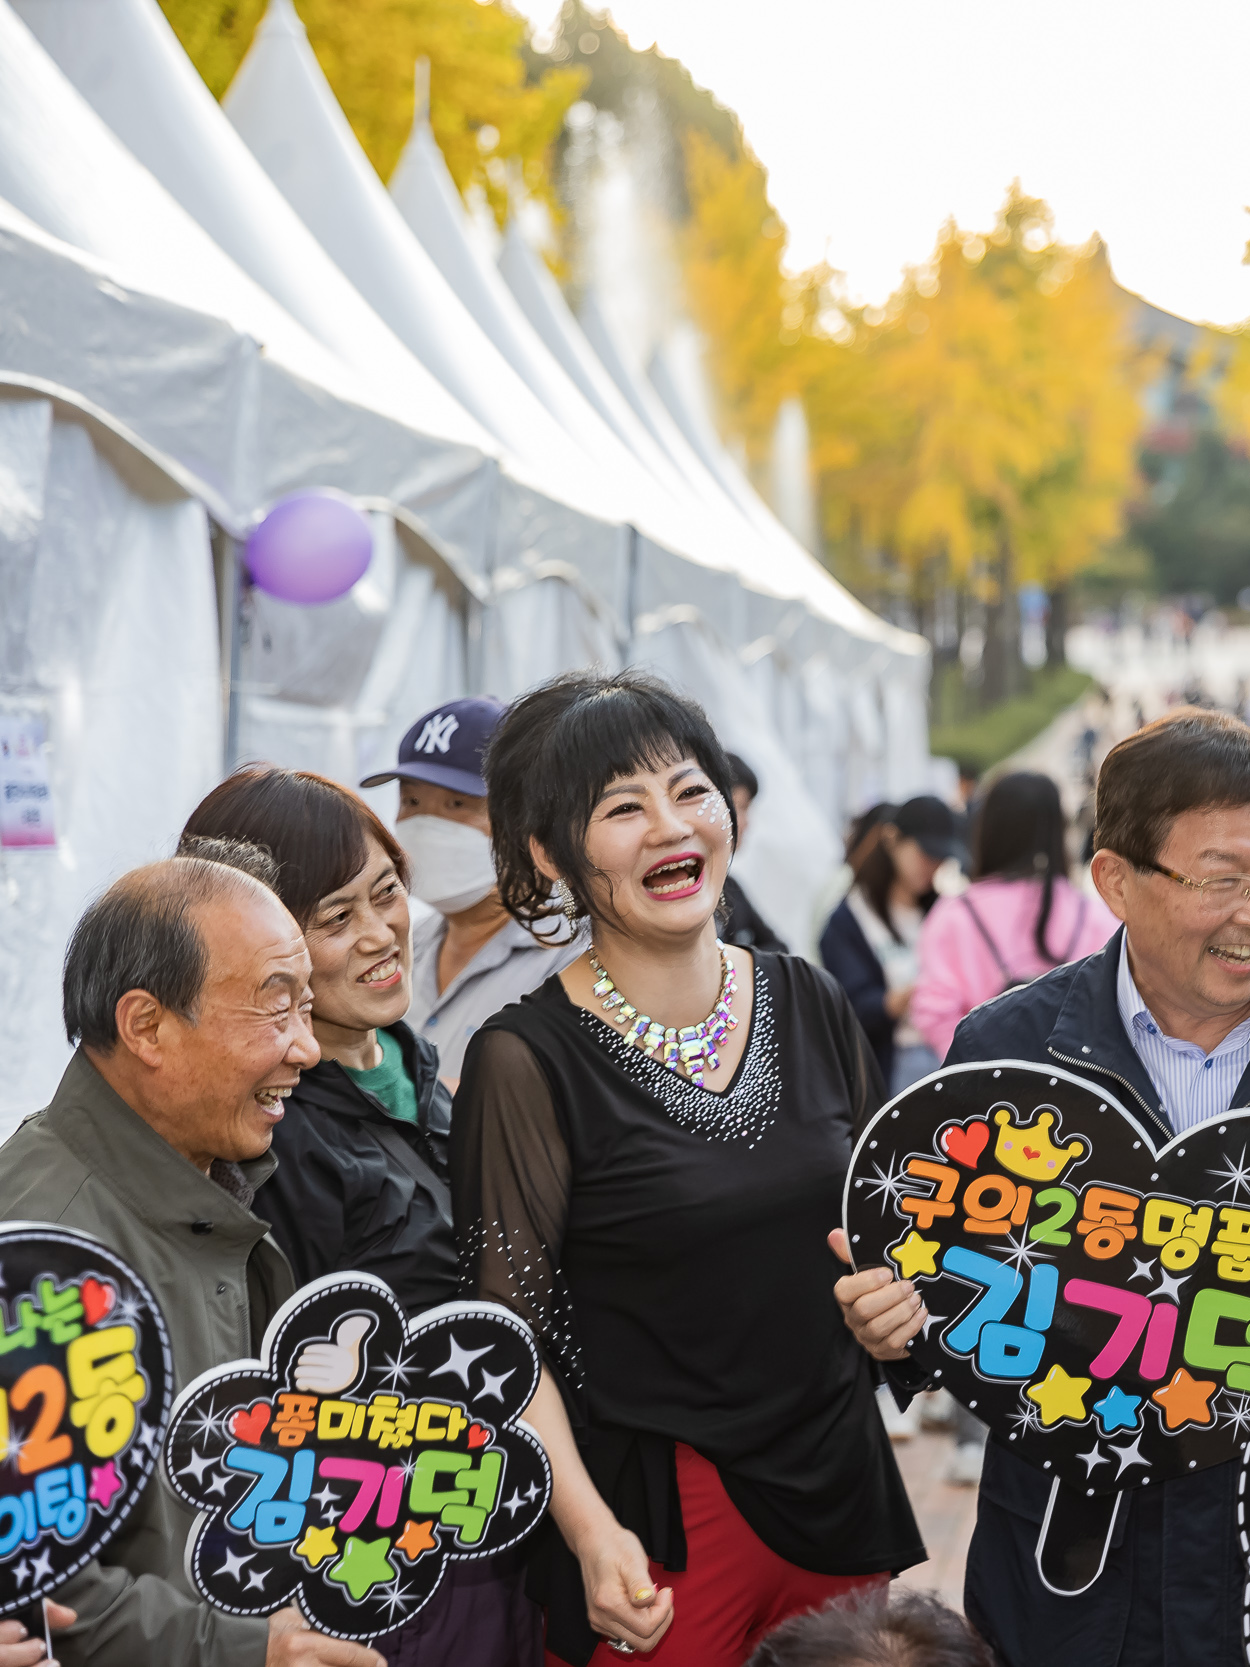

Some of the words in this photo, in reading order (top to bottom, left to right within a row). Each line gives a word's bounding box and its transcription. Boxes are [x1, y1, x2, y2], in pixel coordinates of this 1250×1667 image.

[413, 713, 460, 754] NY
[0, 1326, 146, 1474] 2동
[226, 1447, 502, 1543] 김기덕
